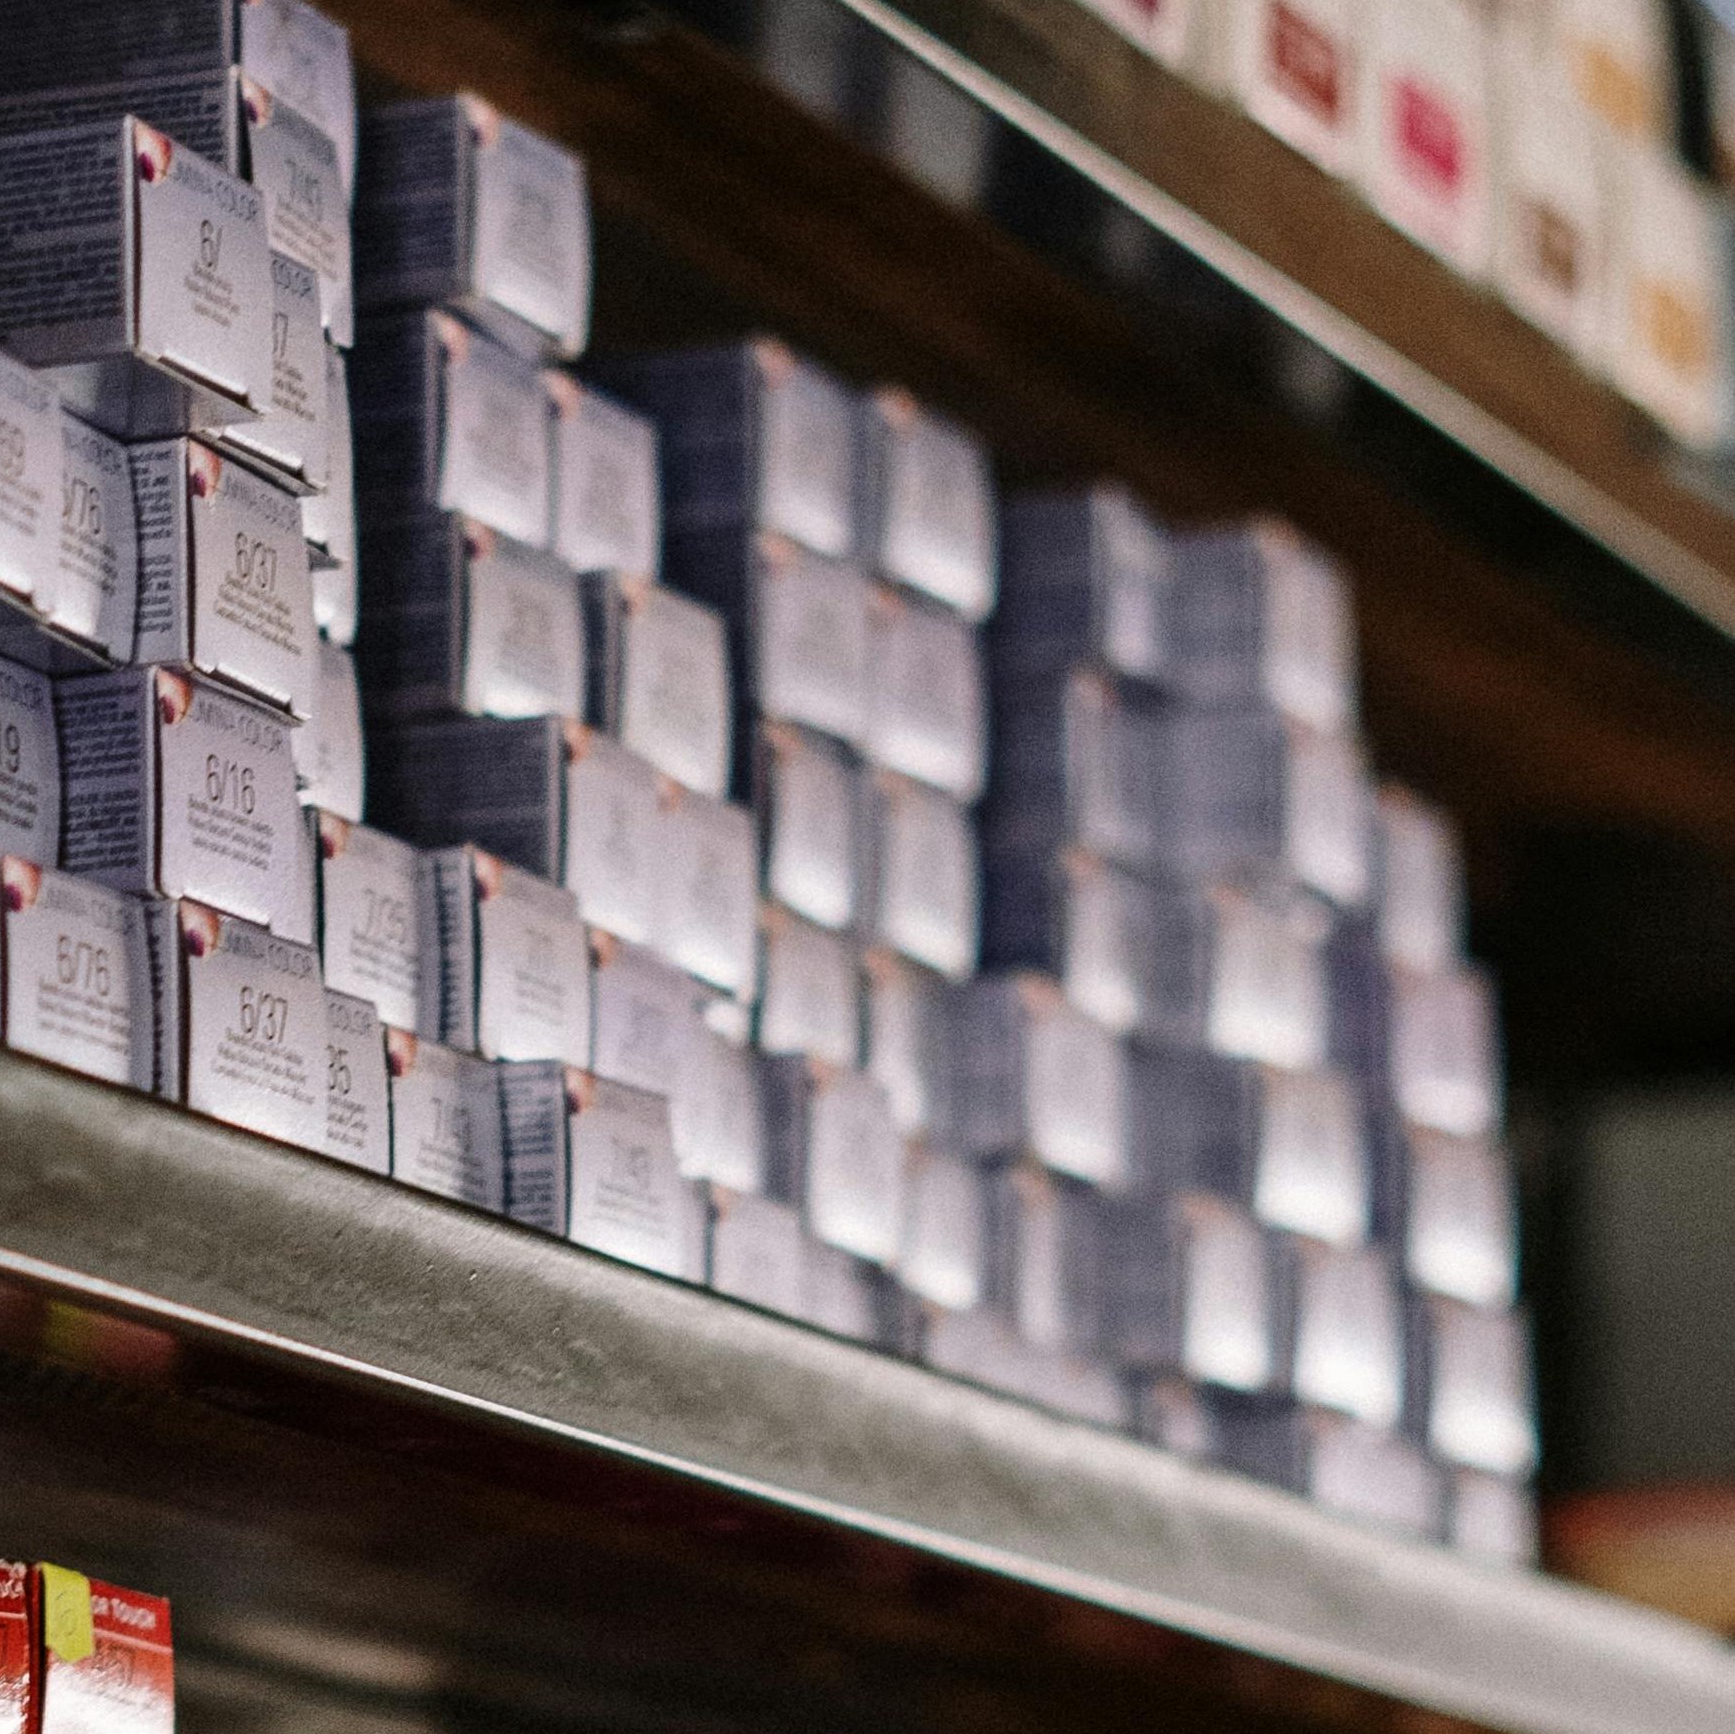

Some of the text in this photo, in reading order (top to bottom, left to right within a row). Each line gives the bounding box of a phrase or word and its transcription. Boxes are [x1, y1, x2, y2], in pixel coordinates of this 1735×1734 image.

[205, 753, 255, 815] 6/16
[58, 934, 110, 997] 6/76
[239, 986, 288, 1043] 6/37
